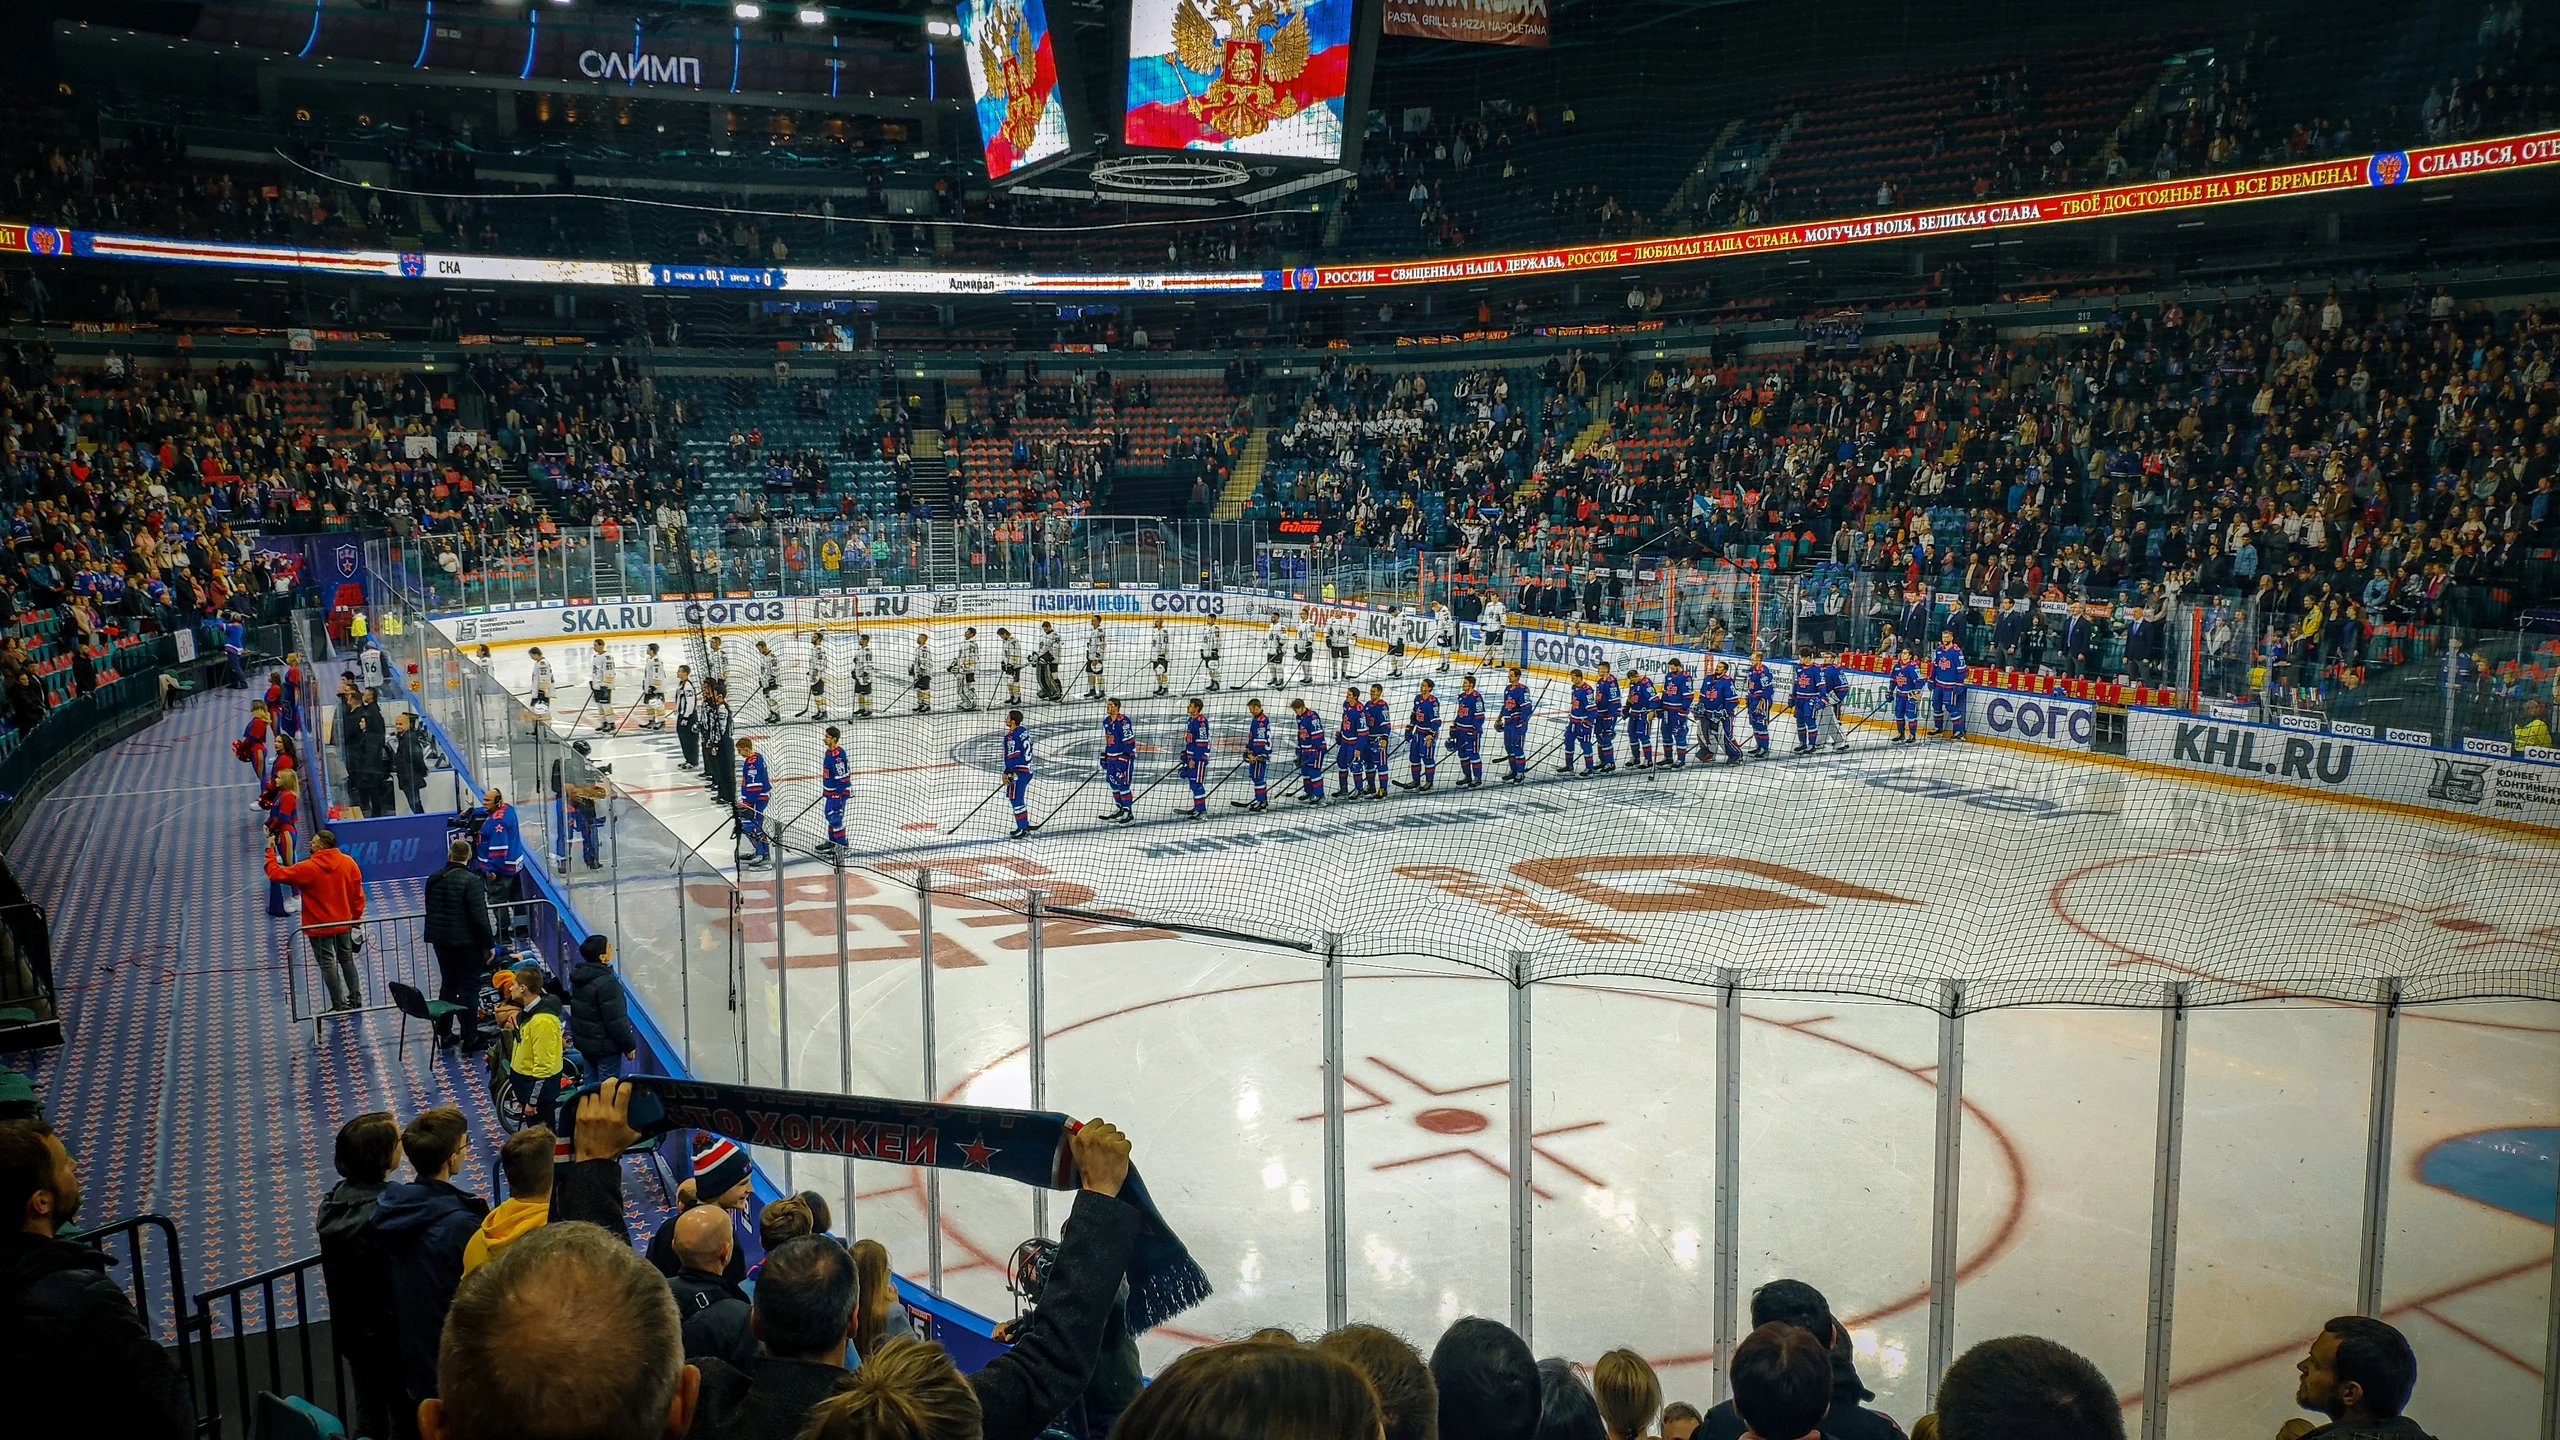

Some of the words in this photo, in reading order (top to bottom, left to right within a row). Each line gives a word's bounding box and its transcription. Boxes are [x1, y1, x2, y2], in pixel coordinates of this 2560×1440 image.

[1387, 12, 1419, 25] PASTA,
[1422, 14, 1448, 27] GRILL
[1460, 19, 1486, 30] PIZZA
[578, 49, 700, 85] ОЛИМП
[2418, 145, 2517, 174] СЛАВЬСЯ,
[1324, 270, 1376, 285] РОССИЯ
[1390, 263, 1464, 282] СВЯЩЕННАЯ
[1465, 261, 1502, 276] НАША
[1504, 256, 1566, 273] ДЕРЖАВА,
[1567, 249, 1618, 267] РОССИЯ
[1633, 242, 1701, 260] ЛЮБИМАЯ
[1703, 236, 1742, 253] НАША
[1745, 230, 1802, 249] СТРАНА.
[1804, 222, 1872, 243] МОГУЧАЯ
[1874, 217, 1916, 236] ВОЛЯ,
[1917, 209, 1987, 230] ВЕЛИКАЯ
[1989, 204, 2041, 223] СЛАВА
[2060, 195, 2101, 216] ТВОЁ
[2103, 185, 2203, 214] ДОСТОЯНЬЕ
[2205, 184, 2231, 200] НА
[2234, 176, 2268, 195] ВСЕ
[2270, 165, 2359, 191] ВРЕМЕНА!
[439, 260, 462, 275] СКА
[949, 277, 994, 291] Адмирал
[2078, 312, 2090, 320] 212
[562, 605, 652, 633] SKA.RU
[814, 596, 909, 620] KHL.RU
[2173, 722, 2355, 784] KHL.RU
[2428, 757, 2493, 806] 15
[2496, 769, 2542, 782] ФОНБЕТ
[2495, 799, 2523, 811] ЛИГА
